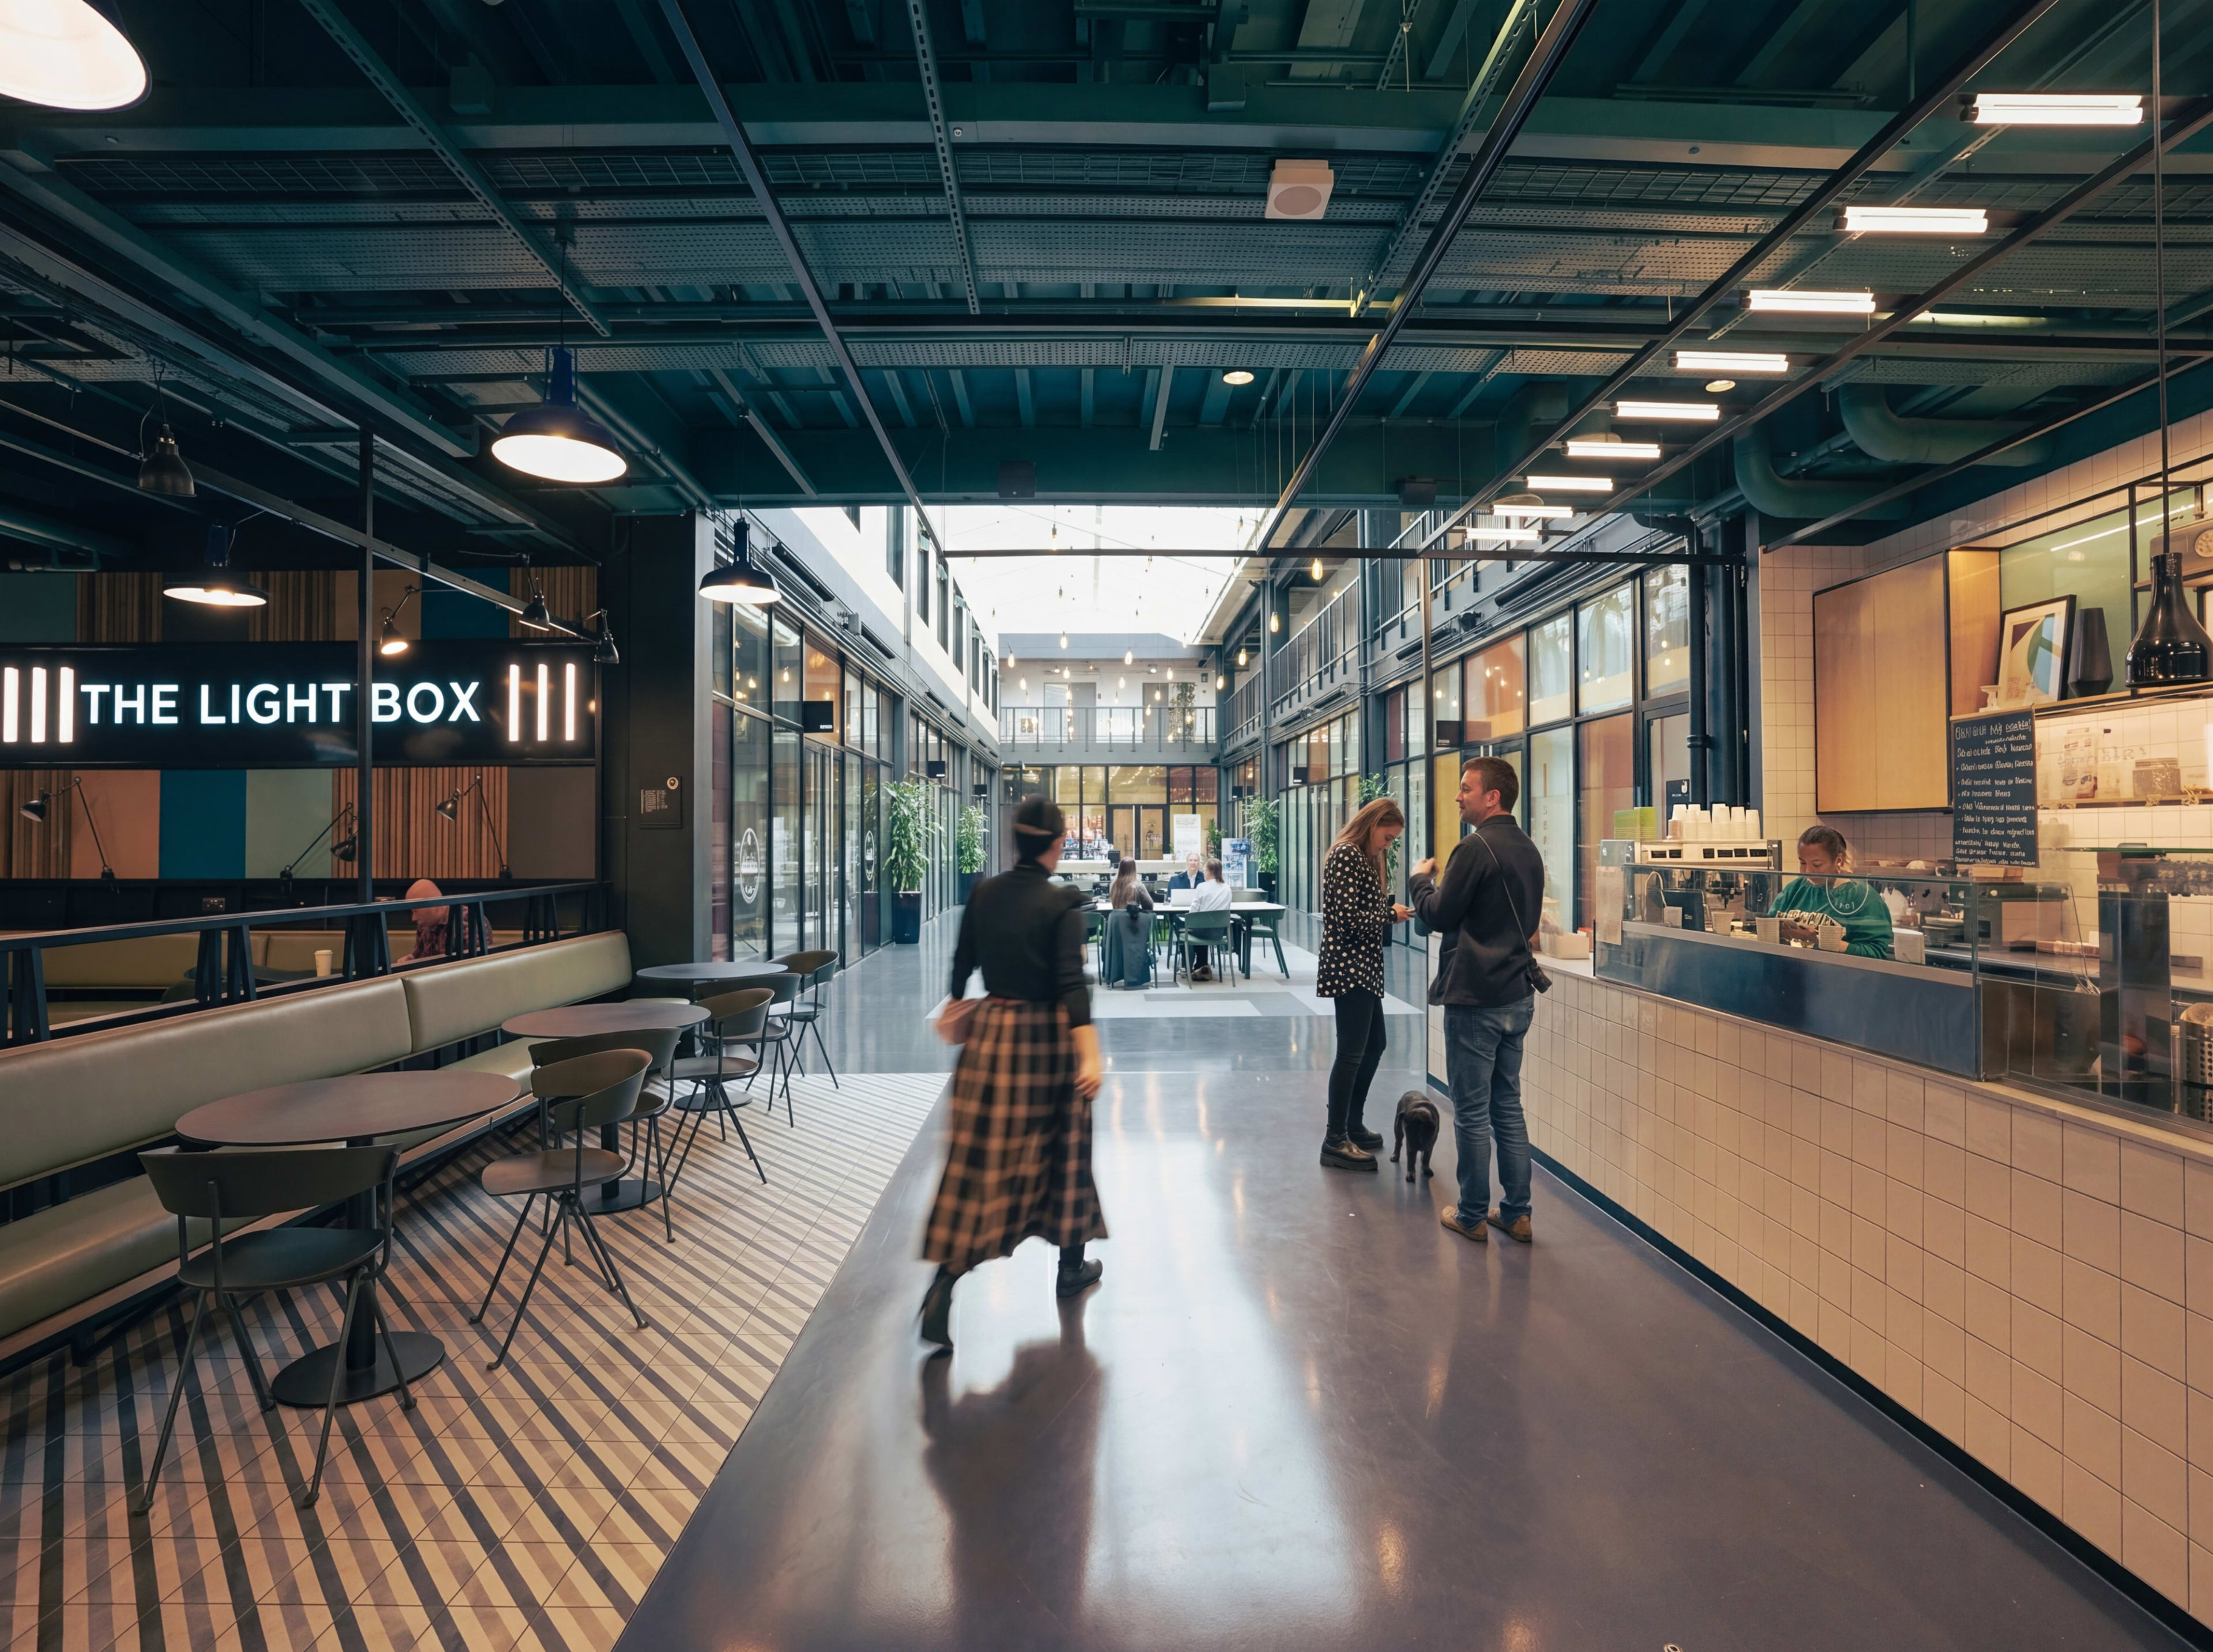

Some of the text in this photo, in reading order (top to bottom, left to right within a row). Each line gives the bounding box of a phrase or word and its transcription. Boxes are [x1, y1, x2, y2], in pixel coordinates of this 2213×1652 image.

[80, 682, 481, 724] THE LIGHT BOX
